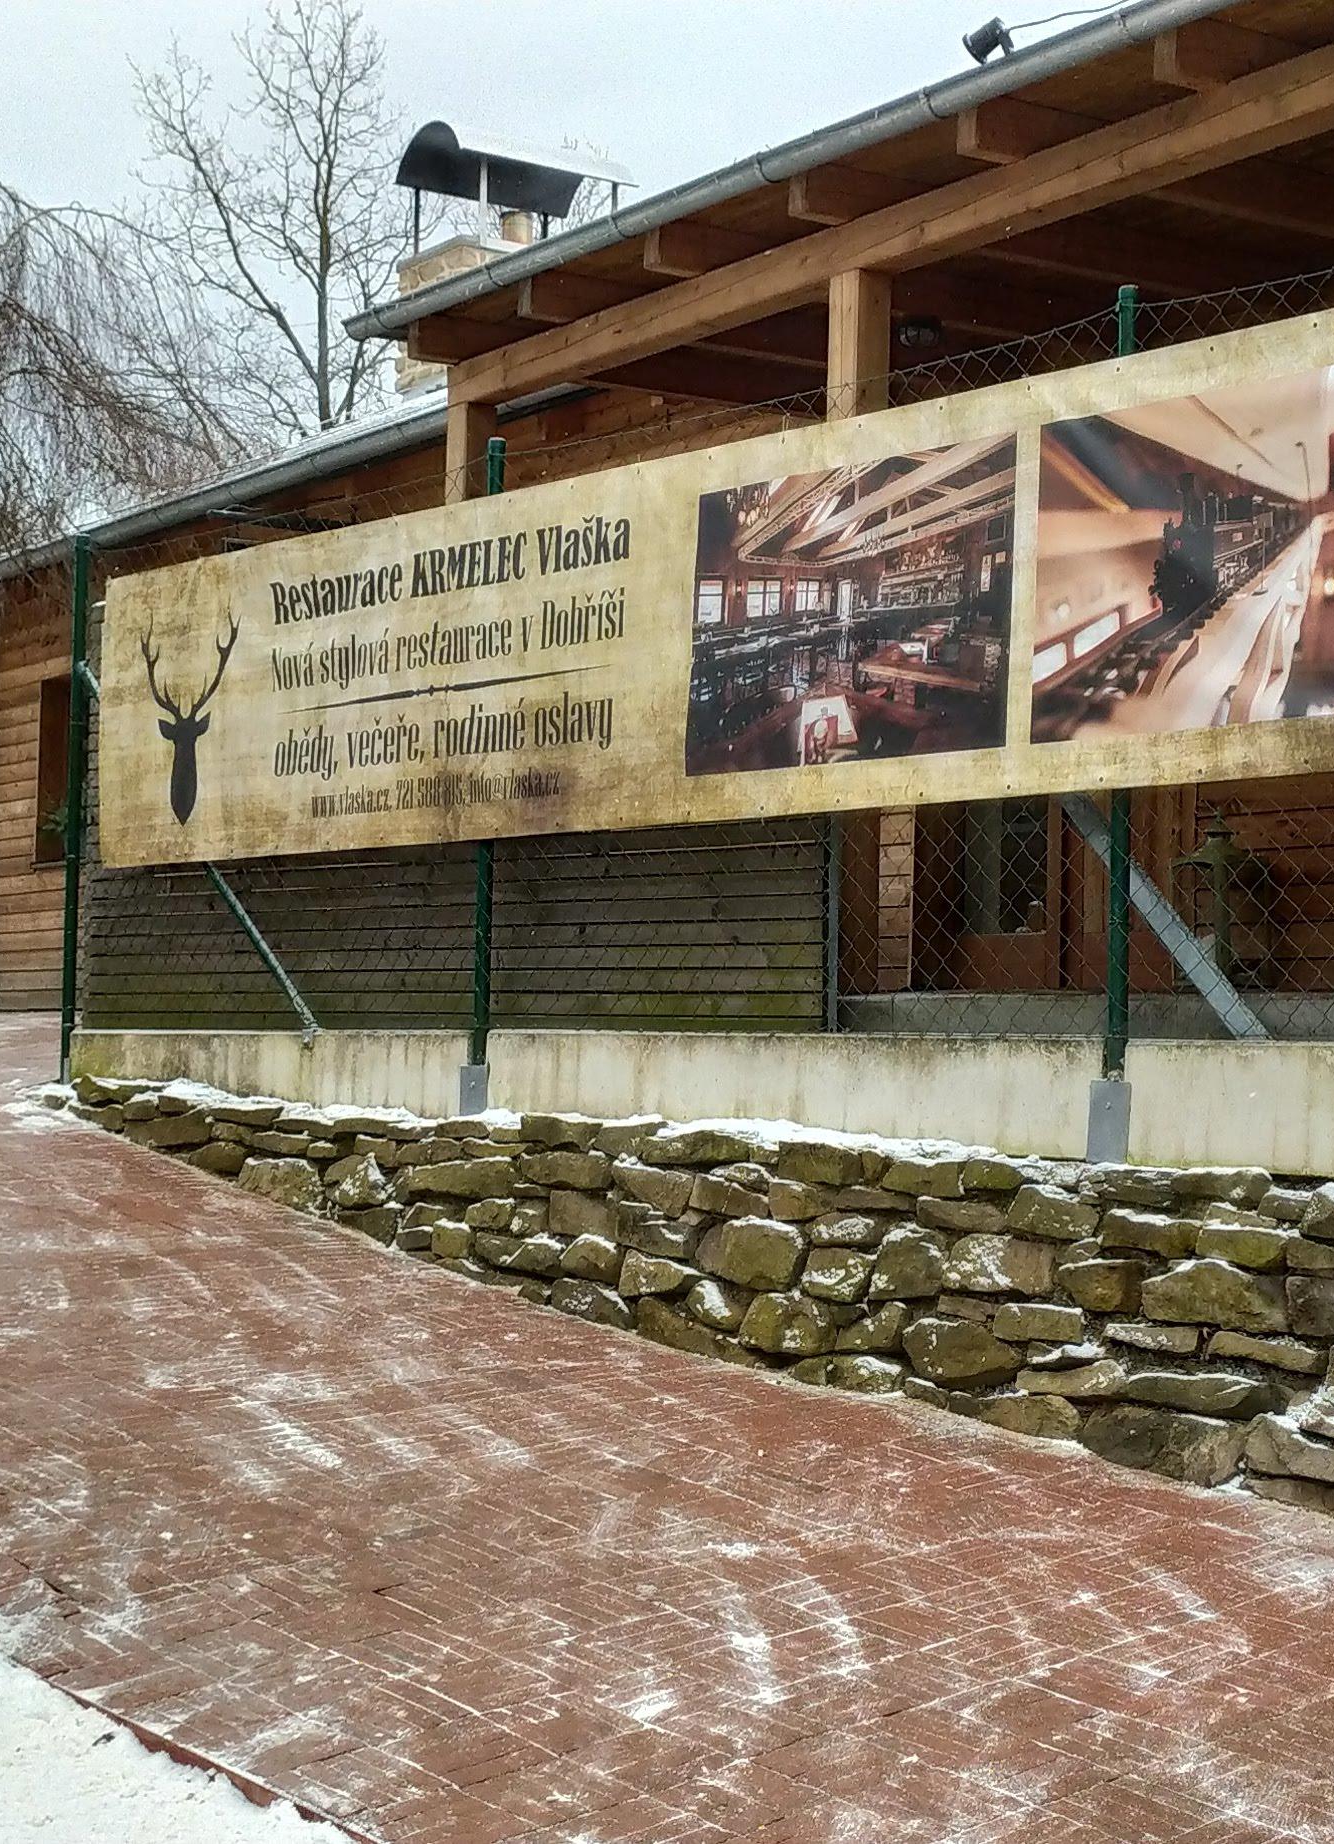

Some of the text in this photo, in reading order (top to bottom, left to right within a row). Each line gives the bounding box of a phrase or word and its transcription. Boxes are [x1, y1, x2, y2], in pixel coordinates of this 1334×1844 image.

[269, 514, 630, 625] Restaurace KRMELEC Vlaška
[271, 587, 625, 692] Nová stylová restaurace v Dobříši
[274, 691, 613, 781] obědy, večeře, rodinné oslavy
[395, 778, 414, 811] 721
